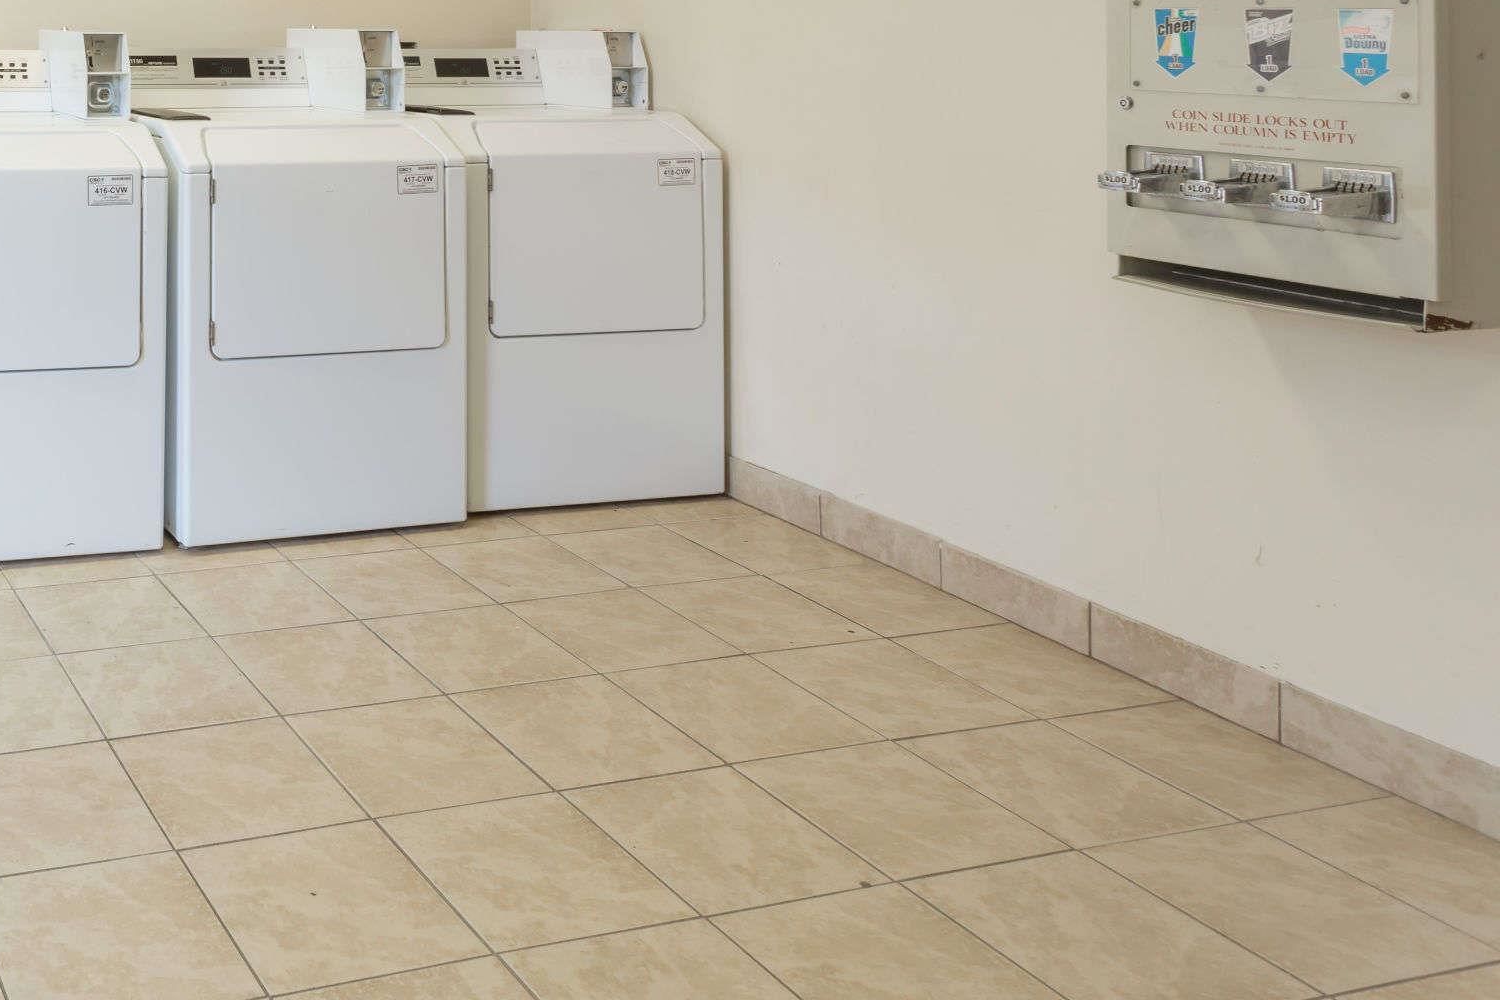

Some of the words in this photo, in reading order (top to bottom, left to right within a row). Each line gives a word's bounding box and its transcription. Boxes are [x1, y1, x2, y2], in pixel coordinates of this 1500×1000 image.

[1157, 16, 1196, 36] cheer
[1172, 108, 1208, 121] COIN
[1211, 111, 1250, 124] SLIDE
[1256, 114, 1307, 128] LOCKS
[1313, 118, 1348, 130] OUT
[1165, 119, 1208, 133] WHEN
[1213, 124, 1278, 138] COLUMN
[1284, 129, 1297, 139] IS
[1302, 130, 1357, 145] EMPTY
[1104, 174, 1128, 185] $1.00
[1187, 183, 1212, 195] $1.00
[1279, 193, 1306, 206] $1.00
